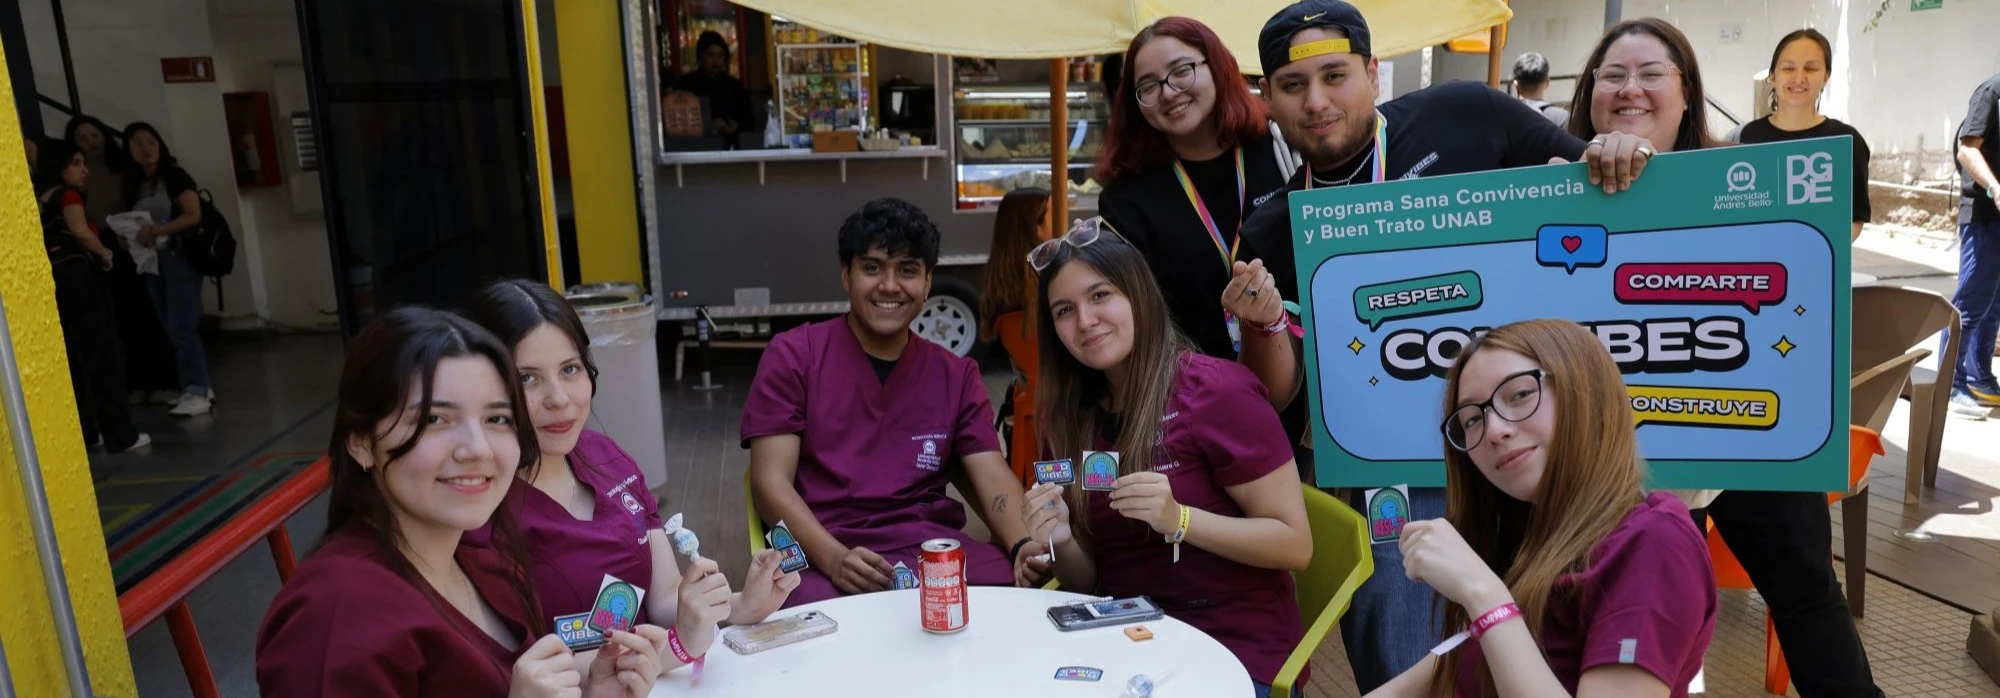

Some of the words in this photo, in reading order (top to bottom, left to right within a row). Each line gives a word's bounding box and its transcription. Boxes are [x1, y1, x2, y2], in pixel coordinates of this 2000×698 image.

[1403, 152, 1438, 180] VIBES
[1302, 200, 1394, 220] Programa
[1401, 193, 1449, 211] Sana
[1456, 179, 1584, 206] Convivencia
[1713, 200, 1746, 210] Andrés
[1749, 198, 1772, 208] Bello
[1714, 191, 1770, 203] Universidad
[1304, 228, 1314, 244] y
[1321, 224, 1369, 240] Buen
[1375, 218, 1425, 236] Trato
[1432, 210, 1493, 230] UNAB
[1629, 274, 1770, 290] COMPARTE
[1368, 284, 1468, 310] RESPETA
[1382, 317, 1746, 376] COBES
[1629, 396, 1766, 416] ONSTRUYE
[1040, 471, 1069, 479] VIBES
